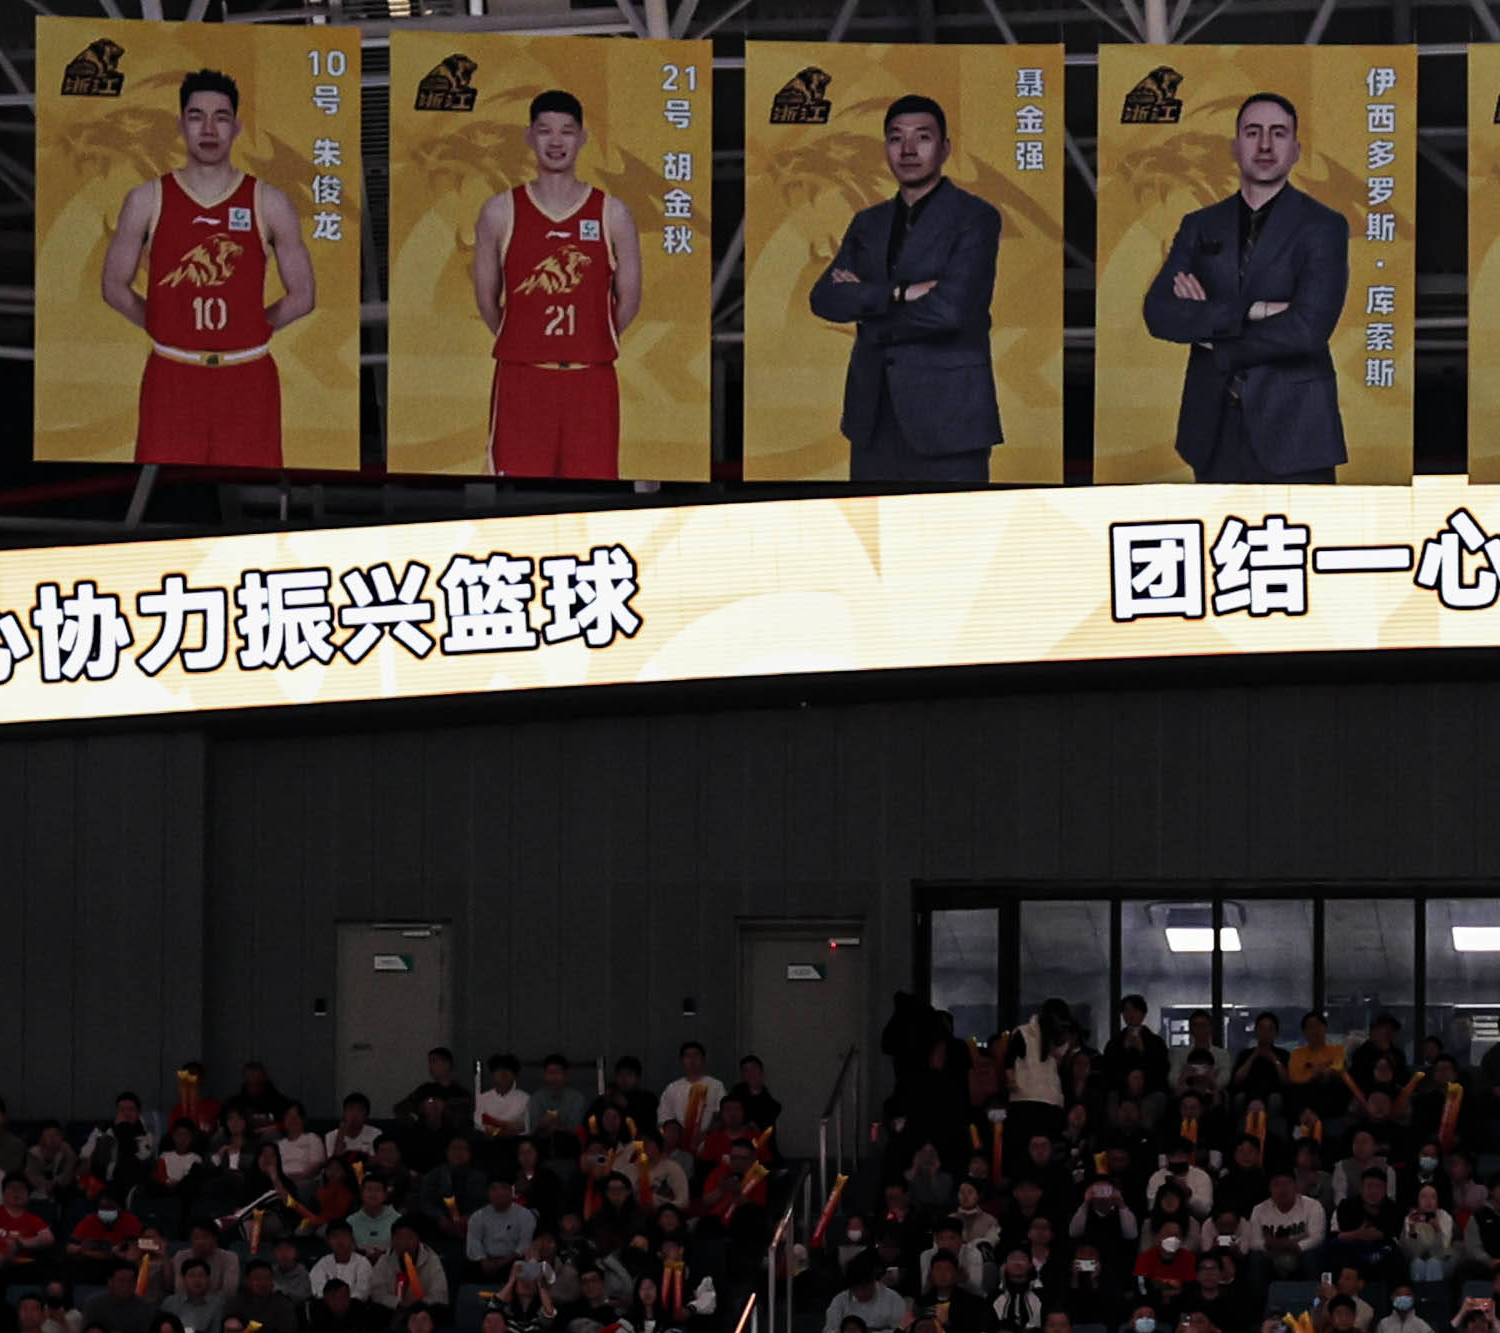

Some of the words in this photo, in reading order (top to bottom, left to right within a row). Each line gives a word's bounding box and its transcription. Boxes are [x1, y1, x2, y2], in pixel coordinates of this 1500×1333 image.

[307, 50, 347, 115] 10号
[662, 65, 697, 128] 21号
[1015, 68, 1044, 170] 聂金强
[311, 138, 343, 240] 朱俊龙
[663, 152, 694, 253] 胡金秋
[1365, 67, 1398, 387] 伊西多罗斯·库索斯
[192, 297, 228, 330] 10
[545, 304, 575, 336] 21
